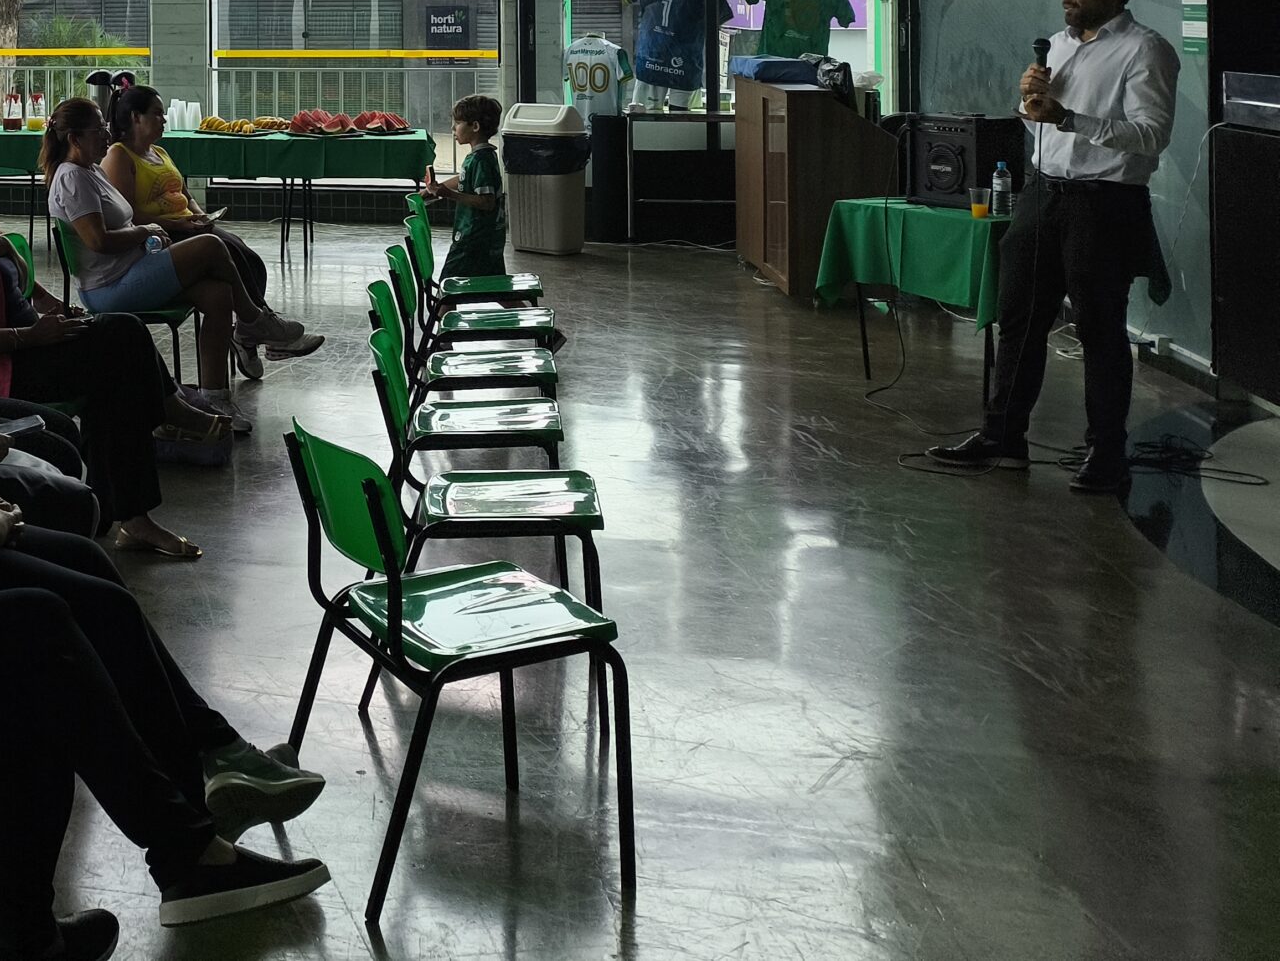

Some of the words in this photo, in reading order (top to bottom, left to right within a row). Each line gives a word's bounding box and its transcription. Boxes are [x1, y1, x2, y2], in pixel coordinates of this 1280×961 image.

[430, 14, 455, 24] horti
[430, 24, 463, 34] natura
[645, 60, 685, 76] Embracon
[567, 61, 610, 94] 100
